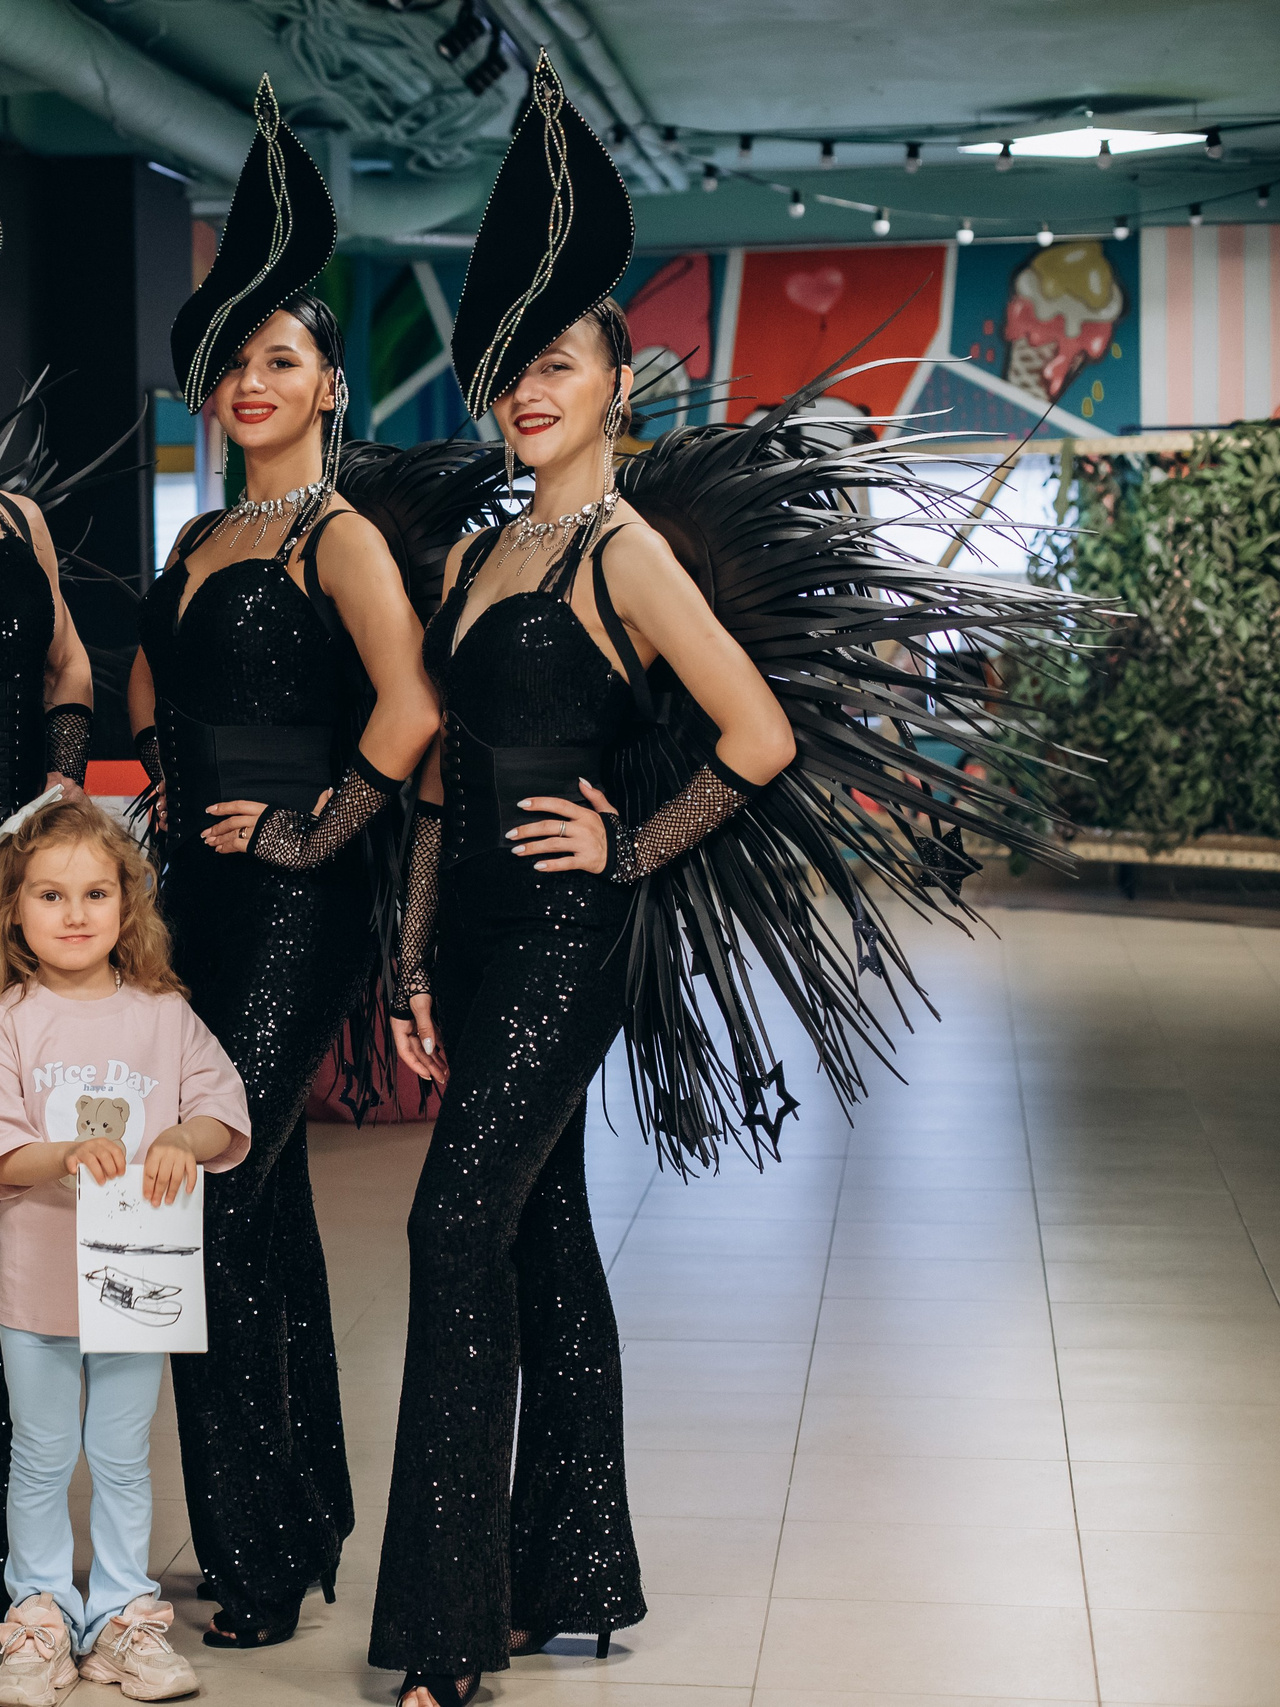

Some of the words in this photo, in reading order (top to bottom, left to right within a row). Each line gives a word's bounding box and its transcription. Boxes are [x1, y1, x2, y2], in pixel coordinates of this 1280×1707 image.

[32, 1061, 97, 1093] Nice
[103, 1059, 160, 1099] Day
[83, 1083, 106, 1092] have
